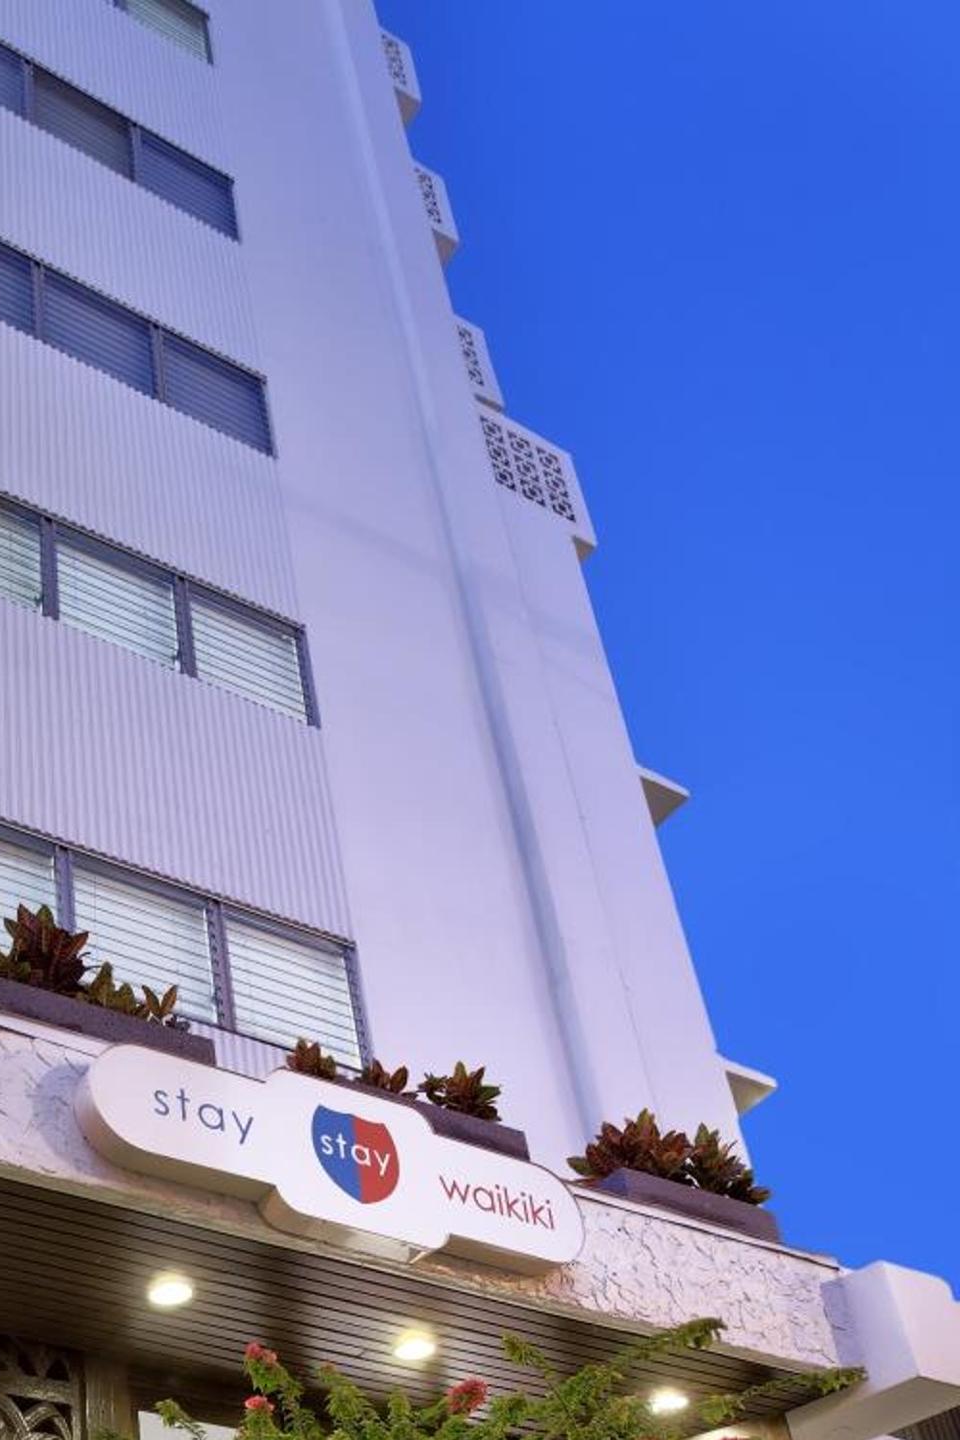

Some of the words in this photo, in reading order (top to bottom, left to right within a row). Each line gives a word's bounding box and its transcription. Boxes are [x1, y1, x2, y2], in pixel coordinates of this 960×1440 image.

[153, 1087, 254, 1144] stay
[320, 1132, 391, 1176] stay
[440, 1176, 555, 1230] waikiki
